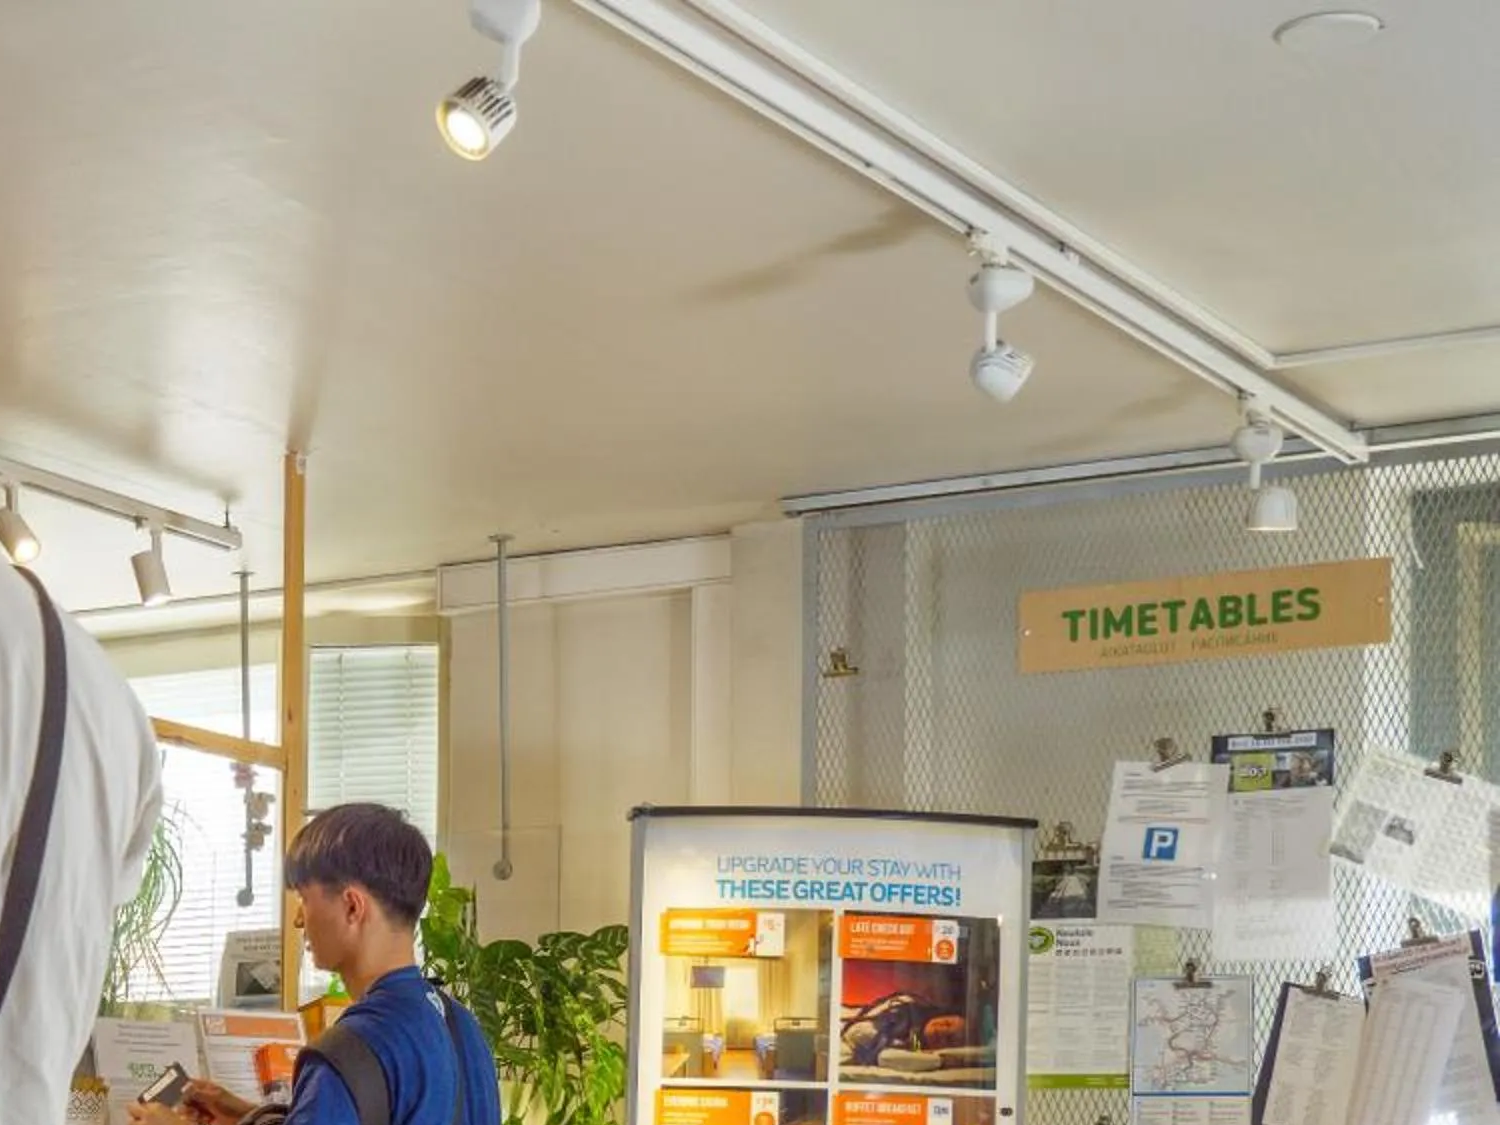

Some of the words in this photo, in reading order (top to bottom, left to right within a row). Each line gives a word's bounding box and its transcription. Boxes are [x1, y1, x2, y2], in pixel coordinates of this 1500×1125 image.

[1062, 587, 1321, 642] TIMETABLES
[717, 856, 807, 875] UPGRADE
[811, 857, 863, 876] YOUR
[867, 859, 909, 878] STAY
[915, 861, 961, 881] WITH
[716, 879, 790, 899] THESE
[793, 880, 868, 901] GREAT
[869, 882, 961, 906] OFFERS!
